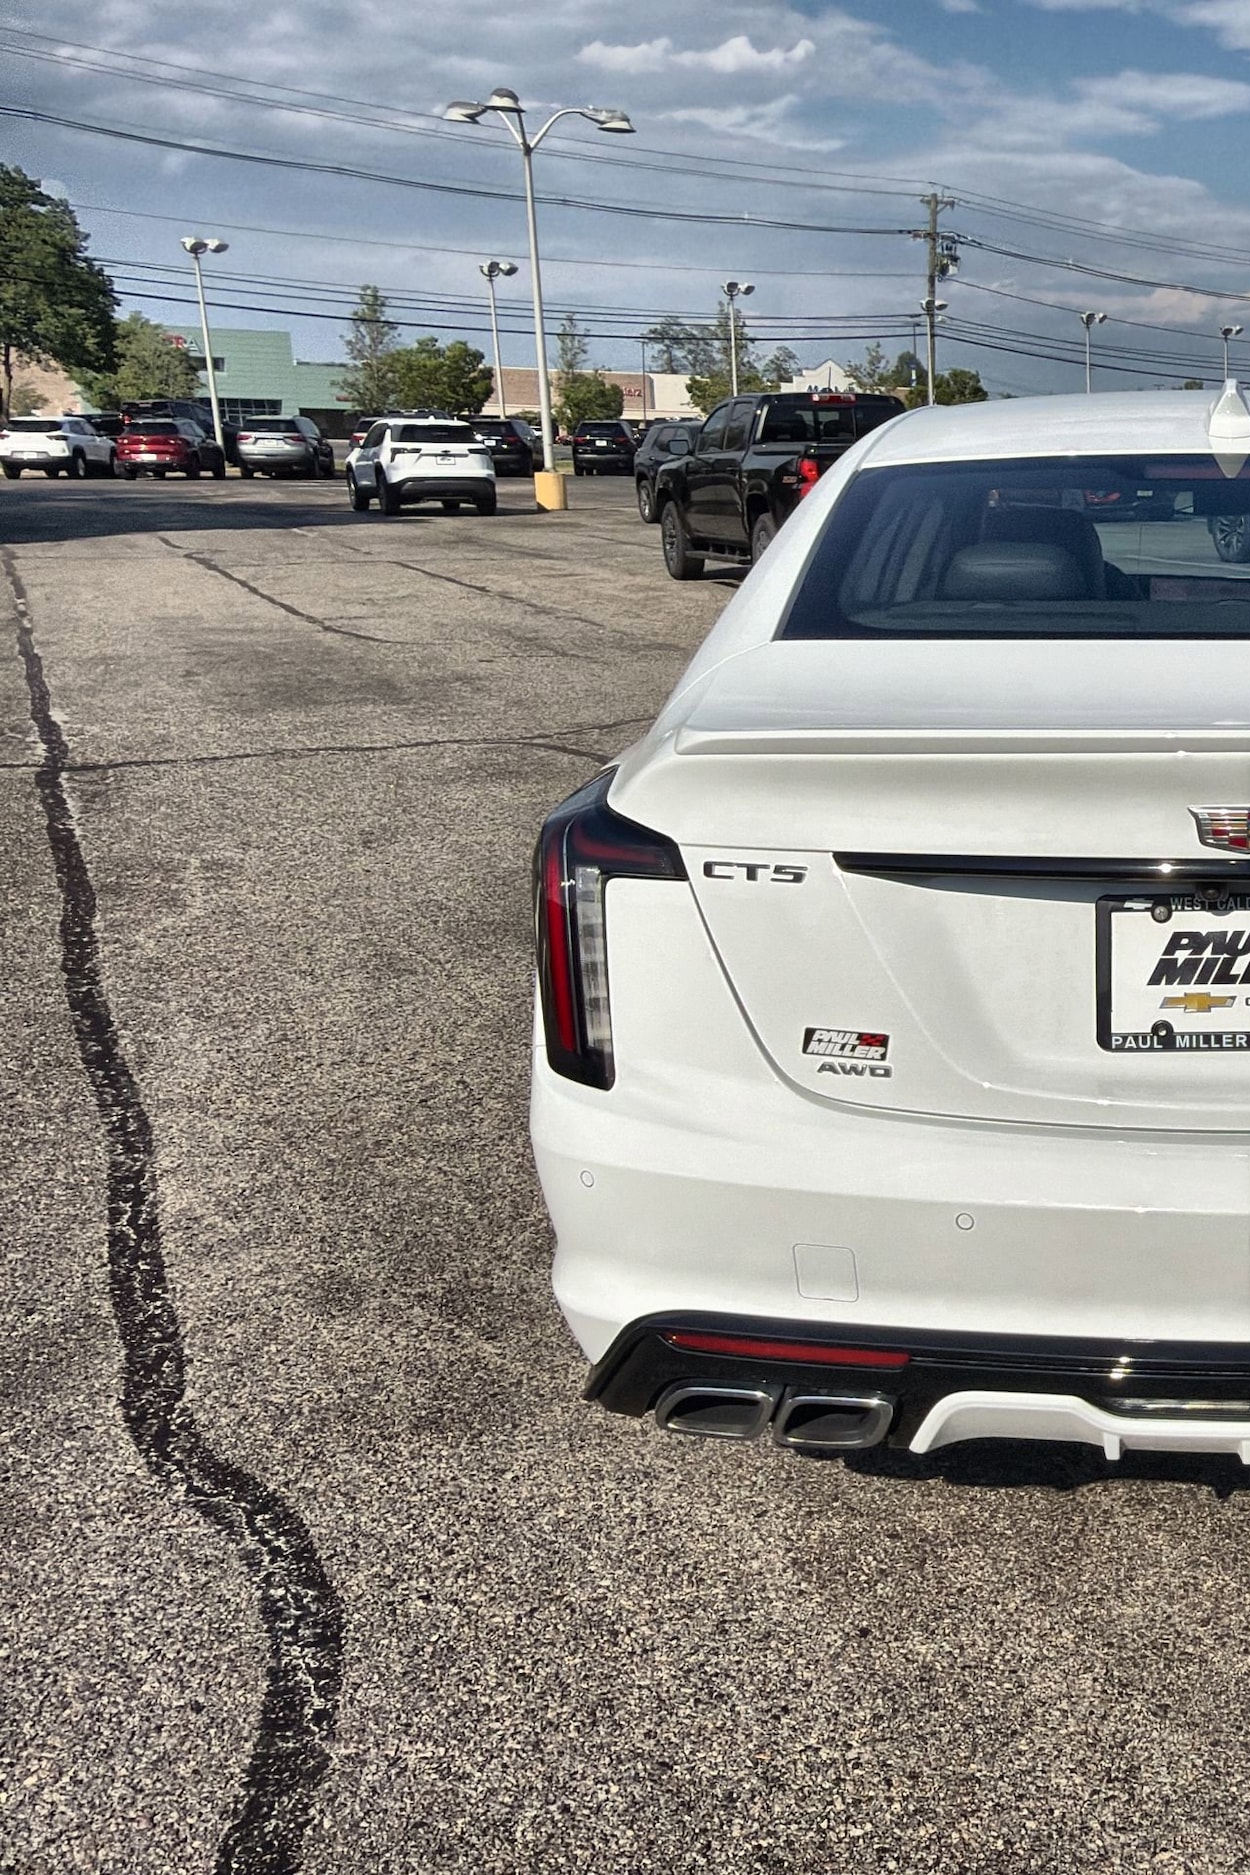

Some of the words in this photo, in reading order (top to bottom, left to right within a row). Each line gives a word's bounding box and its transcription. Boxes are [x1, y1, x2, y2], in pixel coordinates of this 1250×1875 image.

[1170, 897, 1210, 910] WEST
[812, 1029, 860, 1045] PAUL
[1111, 1035, 1163, 1049] PAUL
[1175, 1034, 1248, 1048] MILLER
[806, 1041, 886, 1060] MILLER
[817, 1061, 892, 1078] AWD
